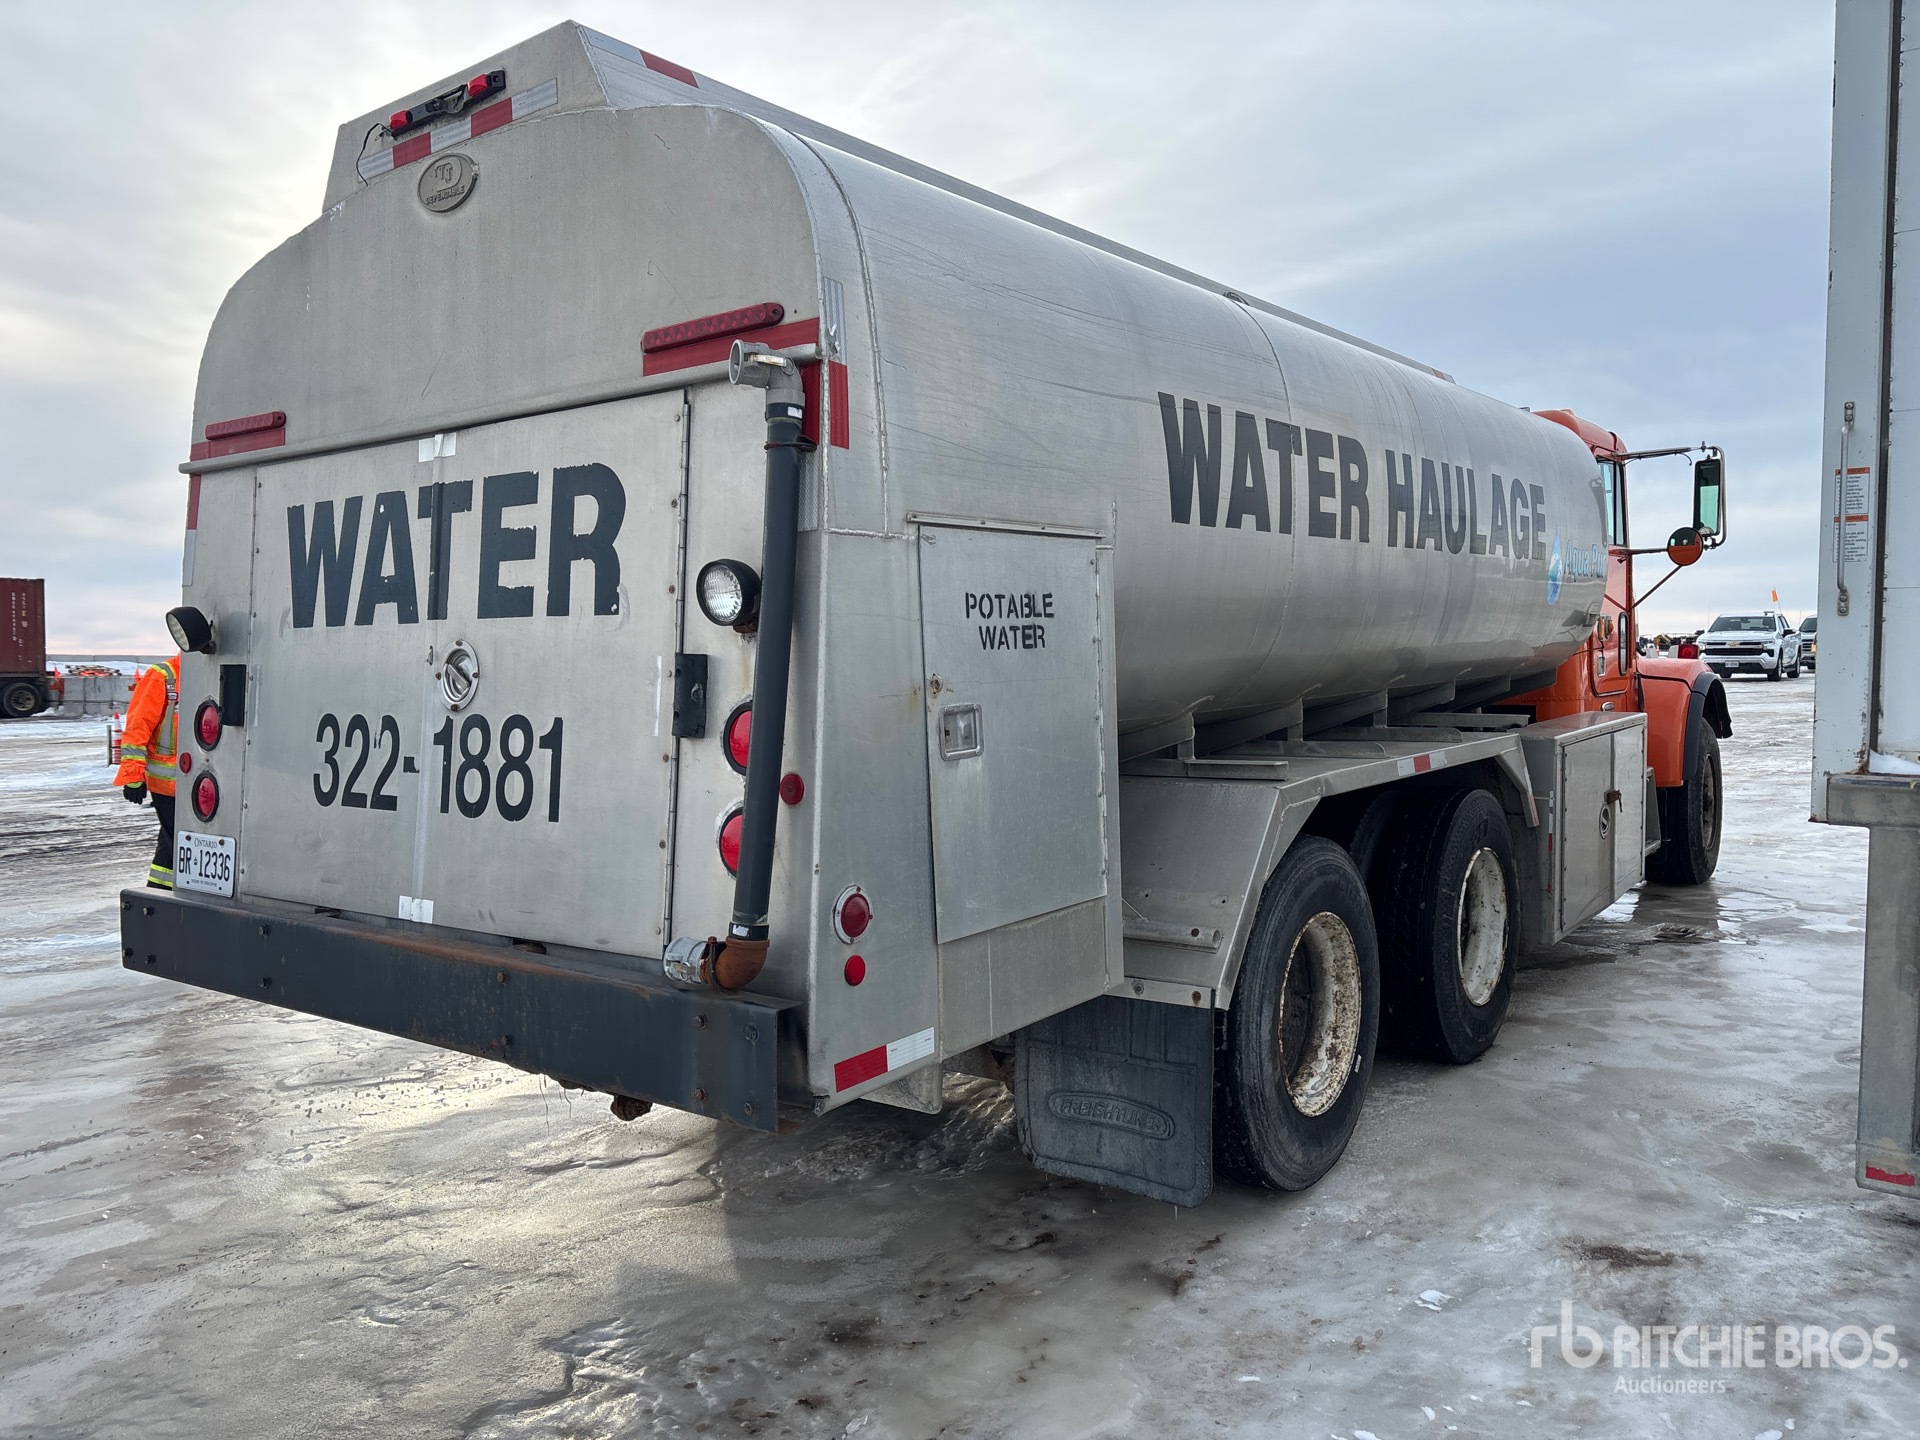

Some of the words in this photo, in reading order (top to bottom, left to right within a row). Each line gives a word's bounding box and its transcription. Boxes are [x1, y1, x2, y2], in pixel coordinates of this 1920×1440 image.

[1158, 391, 1370, 543] WATER
[1386, 449, 1547, 561] HAULAGE
[287, 462, 627, 628] WATER
[1563, 540, 1589, 583] Aqua
[965, 592, 1055, 619] POTABLE
[978, 623, 1046, 650] WATER
[313, 712, 564, 823] 322-1881
[198, 849, 231, 882] 12336
[1059, 1097, 1161, 1131] FREIGHTLINER
